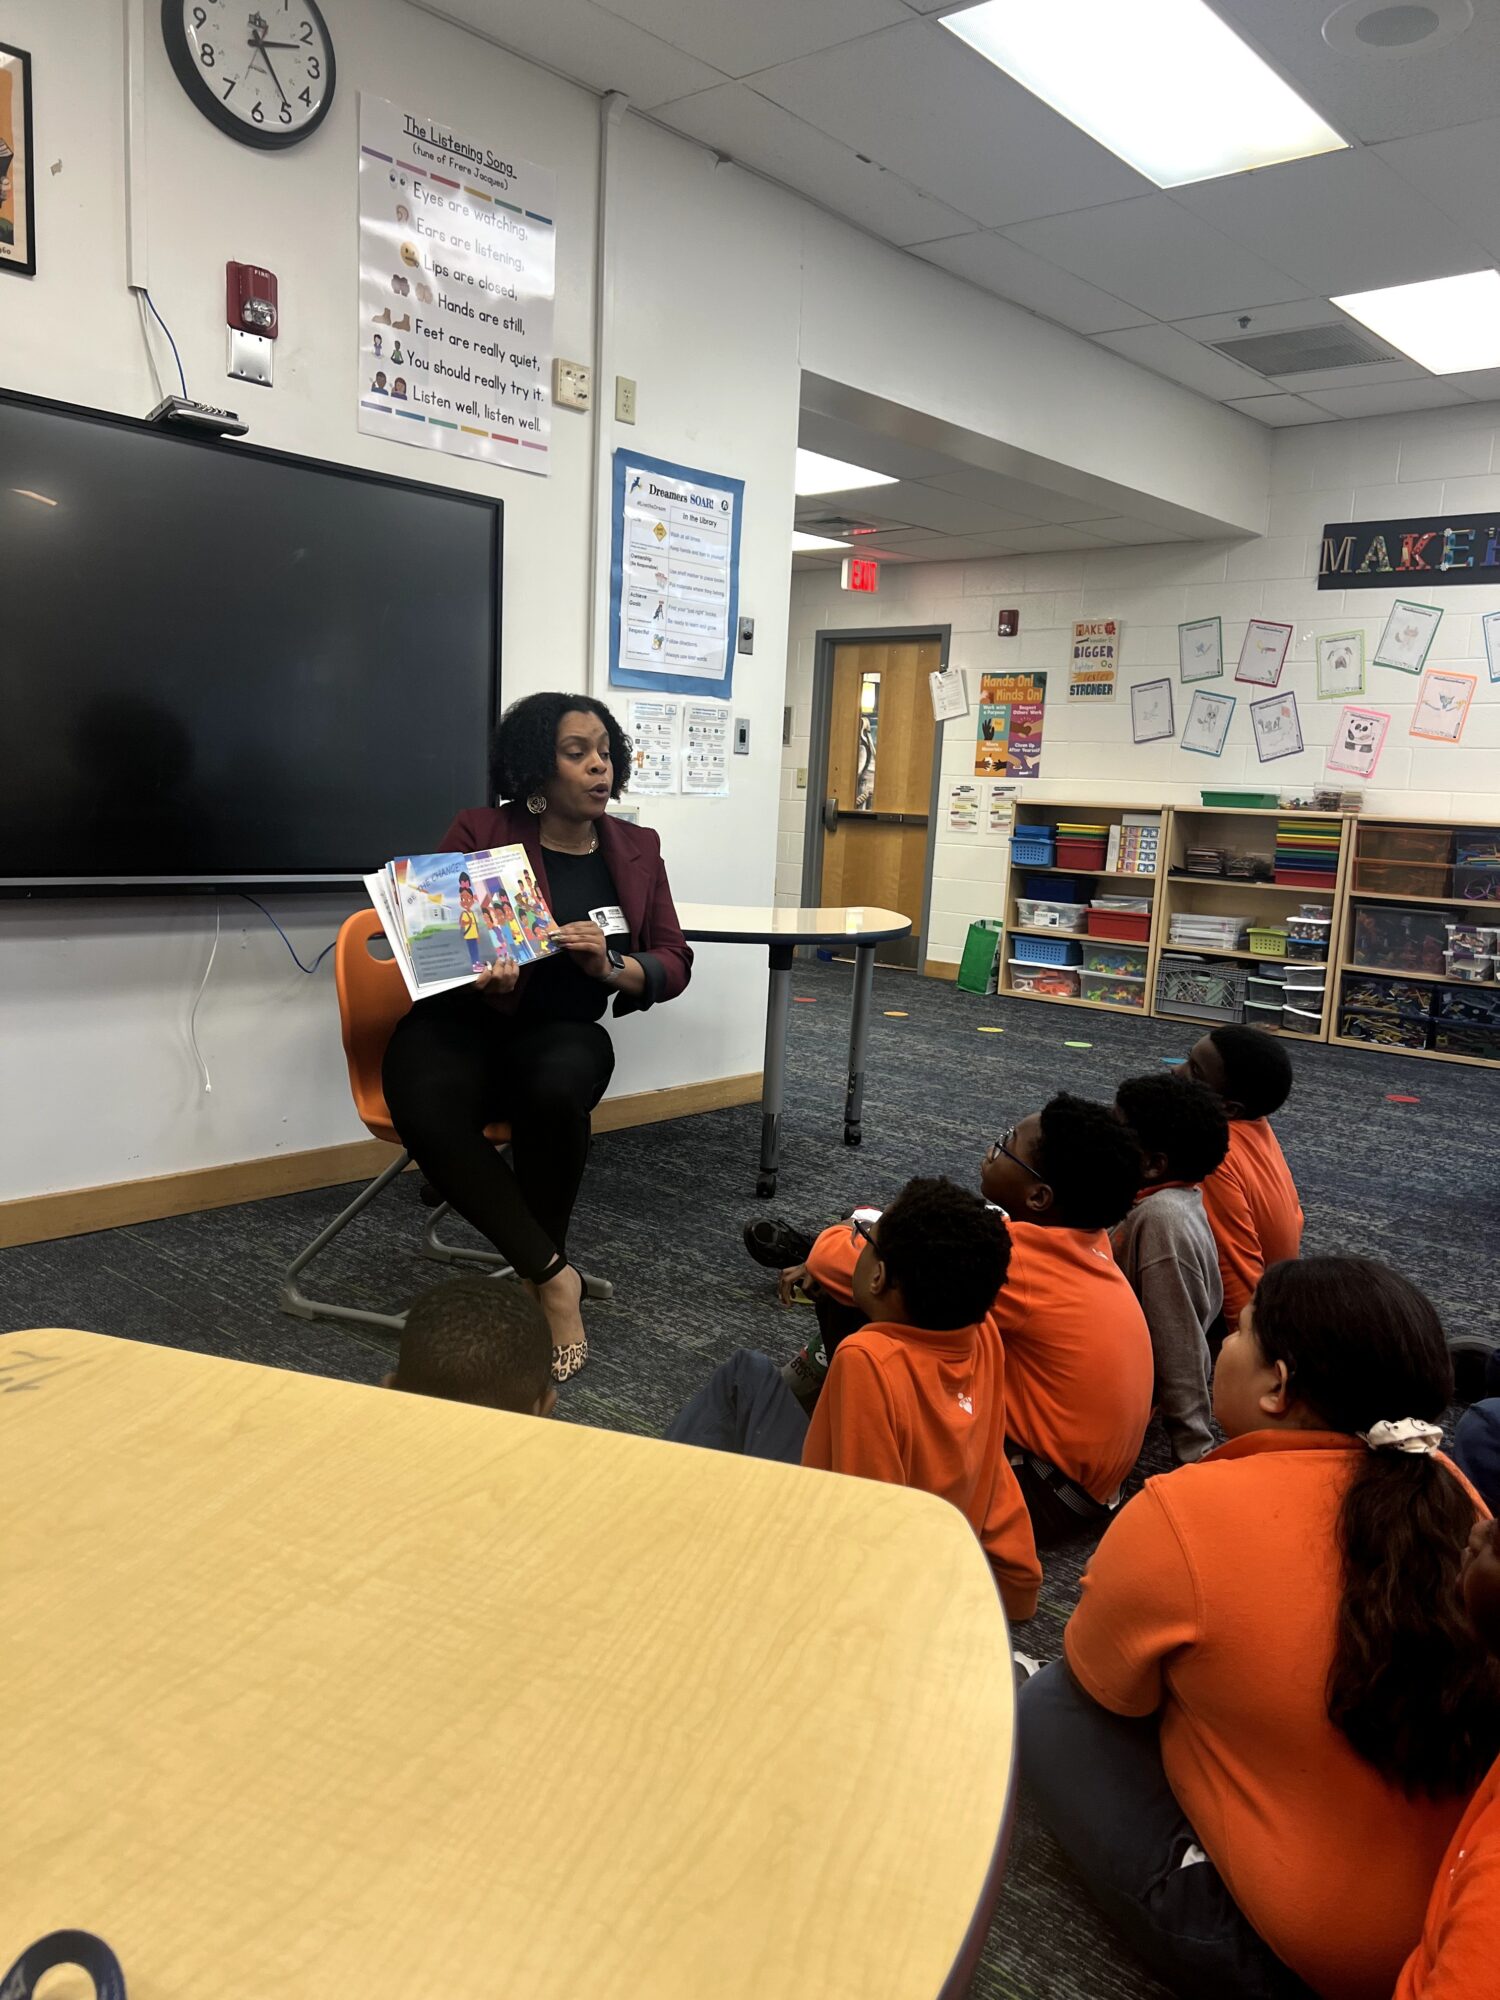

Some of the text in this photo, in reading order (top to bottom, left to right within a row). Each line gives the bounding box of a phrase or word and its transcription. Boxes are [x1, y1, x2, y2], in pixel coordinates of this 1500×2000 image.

[193, 7, 207, 30] 9
[299, 21, 313, 46] 2
[200, 43, 215, 67] 8
[307, 56, 320, 79] 3
[222, 77, 236, 100] 7
[298, 86, 312, 108] 4
[252, 101, 264, 123] 6
[279, 102, 292, 124] 5
[403, 114, 514, 178] The Listening Song
[412, 142, 509, 191] (tune of Frere Jacques)
[413, 181, 529, 241] Eyes are watching,
[416, 217, 525, 272] Ears are listening,
[424, 253, 518, 301] Lips are closed,
[438, 293, 526, 336] Hands are still,
[415, 318, 541, 371] Feet are really quiet,
[407, 349, 545, 402] You should really try it.
[412, 385, 542, 432] Listen well, listen well.
[649, 484, 714, 510] Dreamers SOAR!
[700, 516, 718, 529] Library
[852, 559, 877, 592] EXIT
[1074, 646, 1114, 658] BIGGER
[983, 674, 1035, 687] Hands On!
[1069, 683, 1113, 696] STRONGER
[996, 688, 1043, 702] Minds On!
